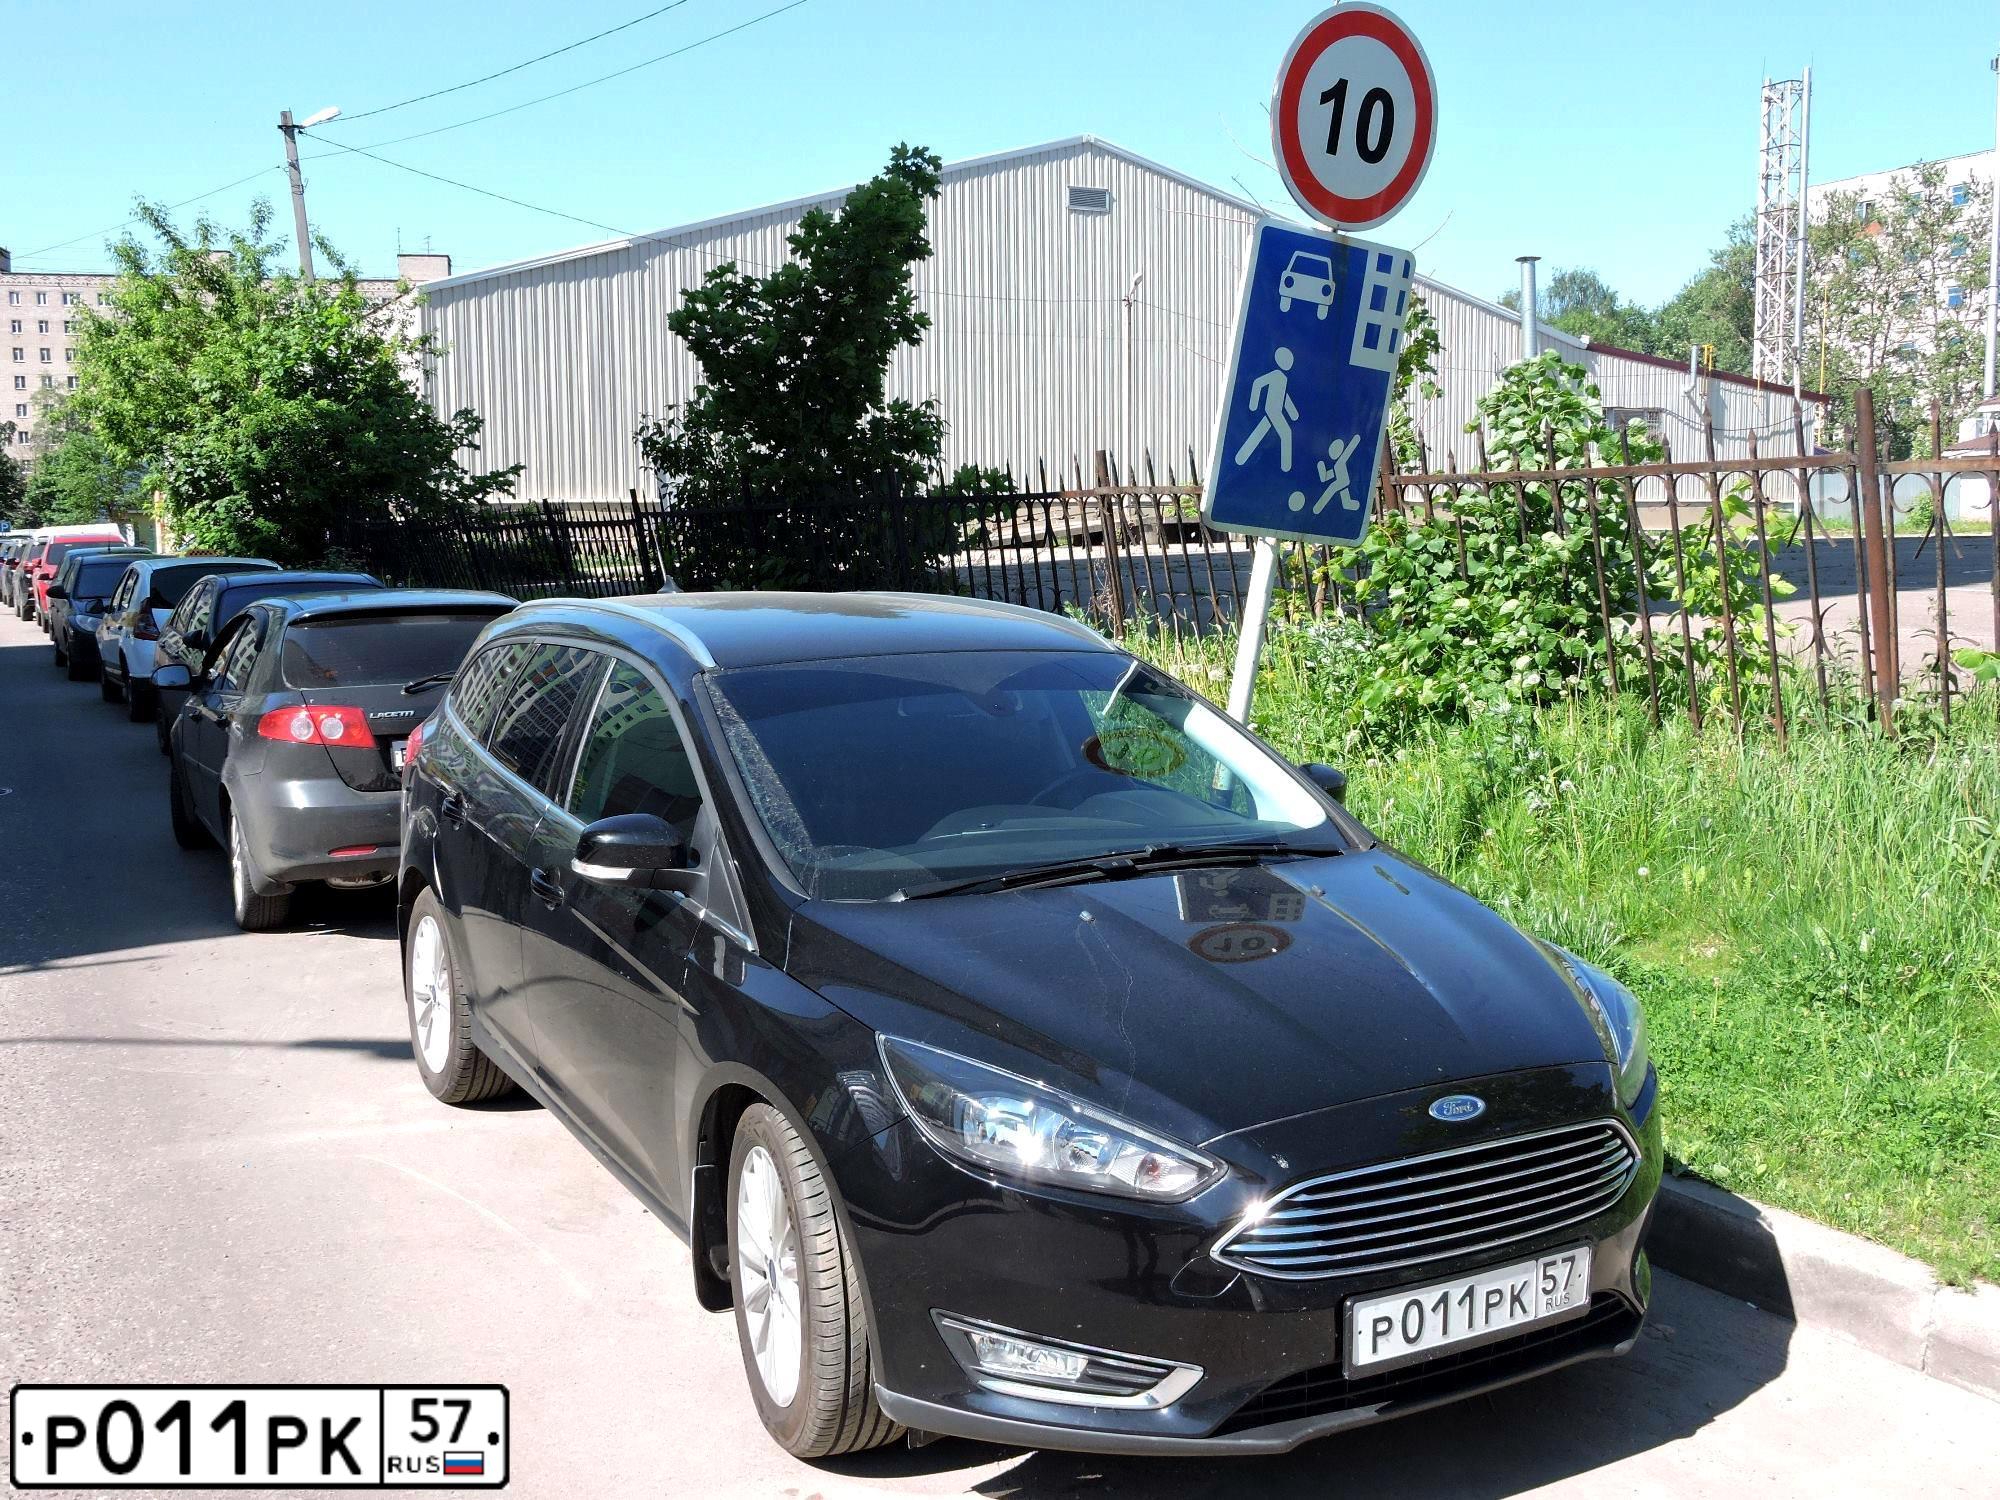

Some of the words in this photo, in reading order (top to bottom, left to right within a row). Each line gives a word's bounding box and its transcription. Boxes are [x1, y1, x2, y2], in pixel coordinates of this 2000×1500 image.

[1319, 77, 1395, 164] 10
[369, 710, 415, 719] LACETTI
[1442, 1101, 1474, 1116] Ford
[1371, 1279, 1528, 1354] P011PK
[1540, 1255, 1577, 1295] 57
[1545, 1292, 1571, 1313] RUS
